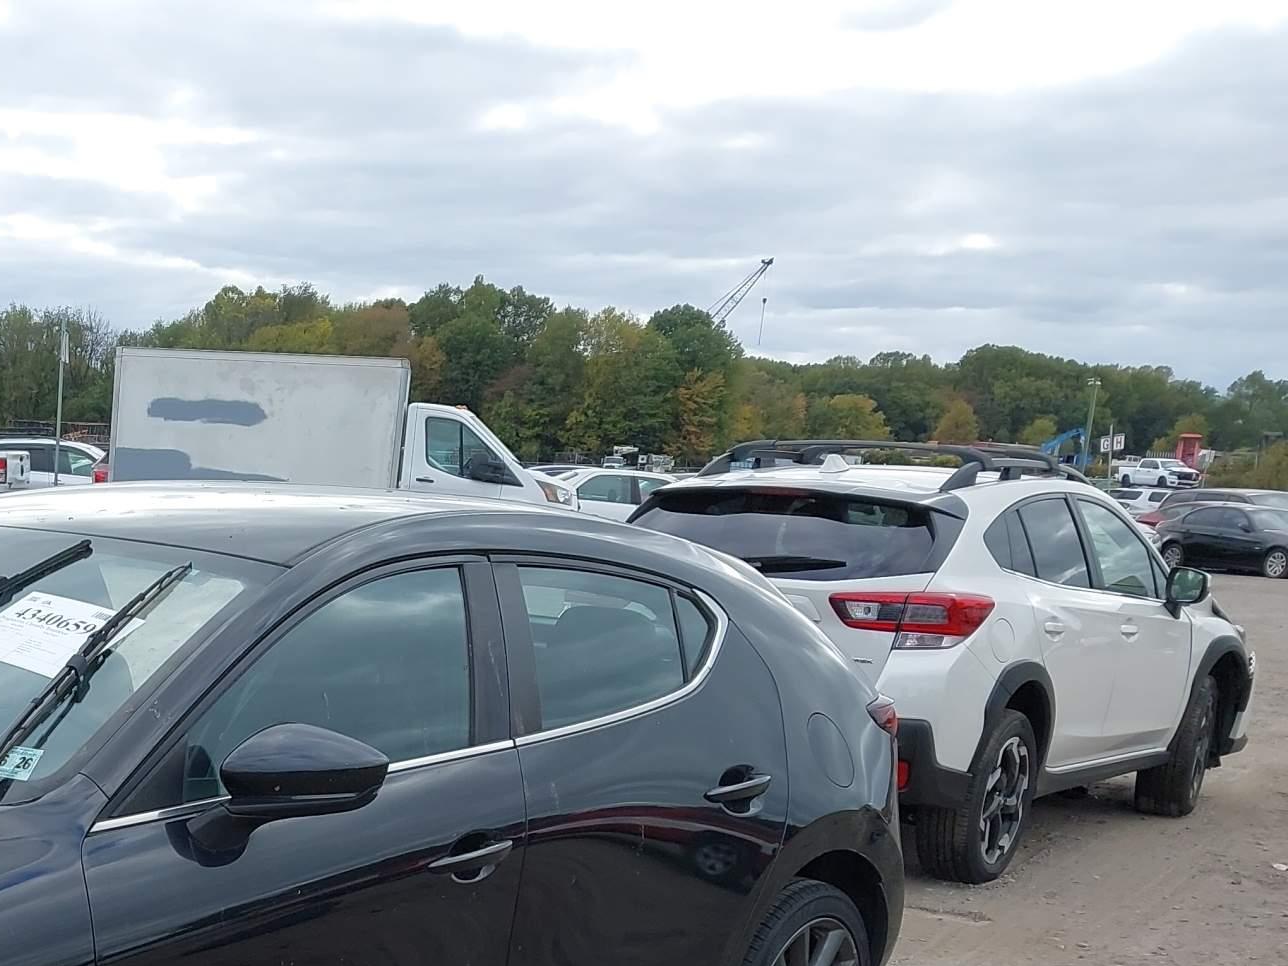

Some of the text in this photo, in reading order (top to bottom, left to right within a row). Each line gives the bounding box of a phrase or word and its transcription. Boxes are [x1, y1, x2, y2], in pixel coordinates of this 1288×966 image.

[1102, 439, 1110, 450] G
[1115, 437, 1123, 448] H
[15, 756, 33, 770] 26
